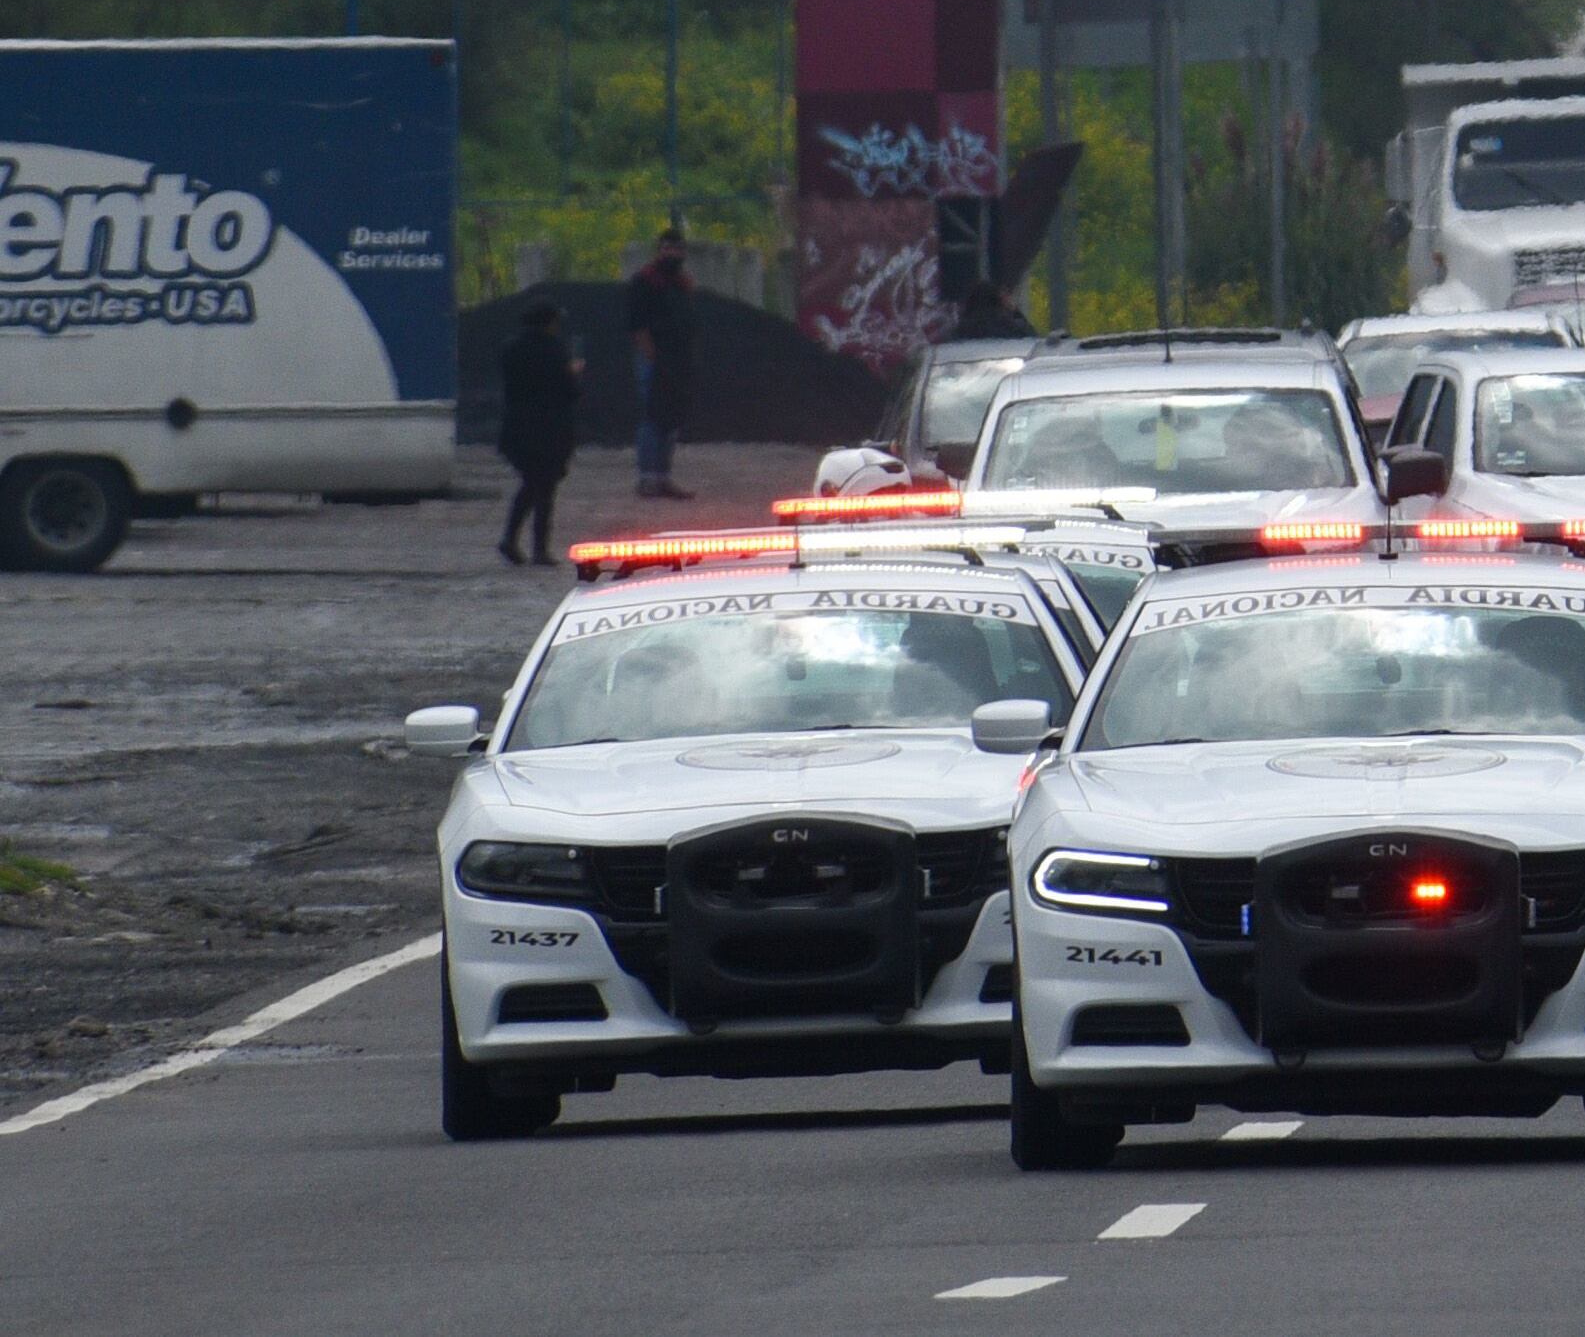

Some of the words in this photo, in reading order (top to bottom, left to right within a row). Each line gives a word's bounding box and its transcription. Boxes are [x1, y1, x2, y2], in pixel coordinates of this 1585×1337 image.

[0, 158, 272, 278] ento
[352, 225, 430, 246] Dealer
[341, 249, 443, 268] Services
[773, 828, 809, 843] GN
[1369, 843, 1408, 856] GN
[490, 929, 580, 947] 21437
[1066, 946, 1163, 966] 21441
